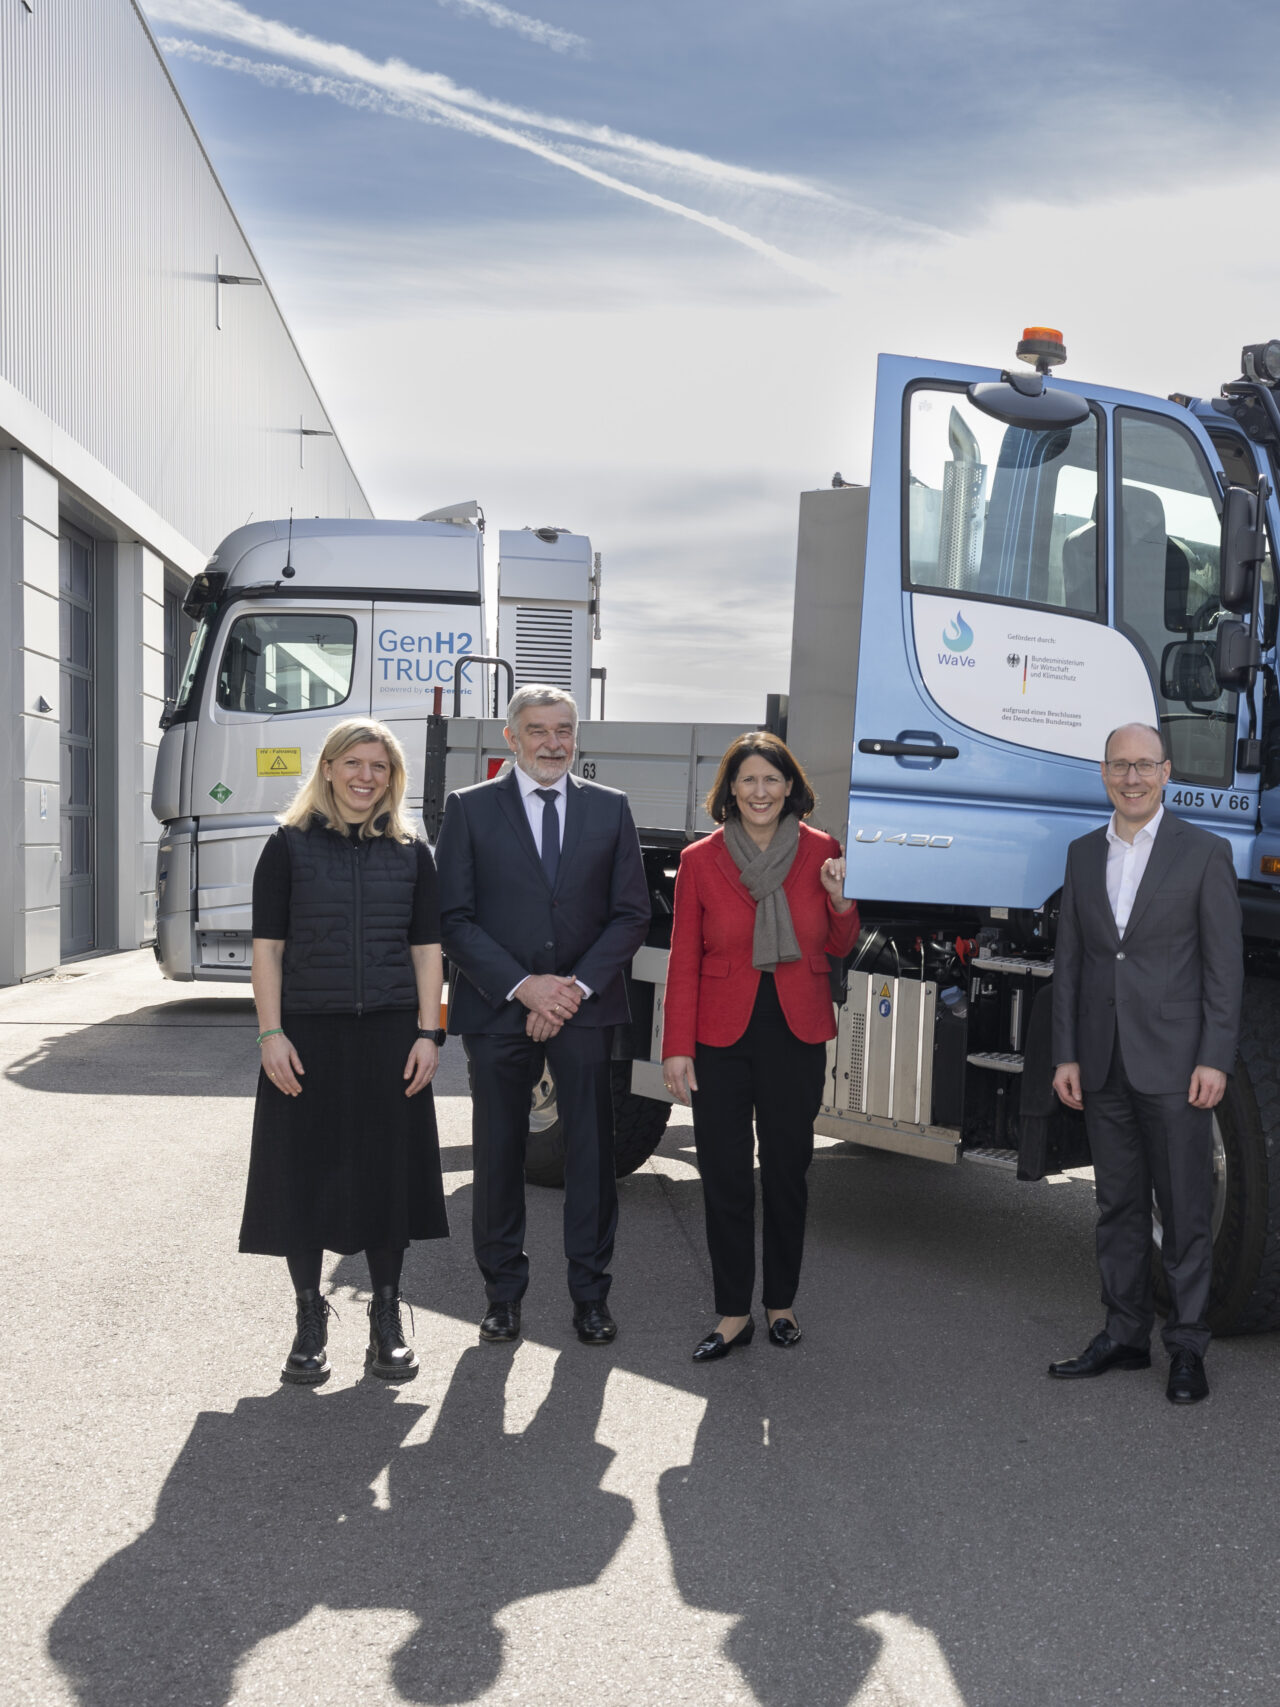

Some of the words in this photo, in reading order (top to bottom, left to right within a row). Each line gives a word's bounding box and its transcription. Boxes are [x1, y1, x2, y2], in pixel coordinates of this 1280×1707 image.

[378, 629, 473, 655] GenH2
[1007, 633, 1036, 643] Gefördert
[1037, 636, 1057, 644] durch:
[937, 653, 976, 668] WaVe
[1031, 655, 1085, 667] Bundesministerium
[377, 657, 474, 684] TRUCK
[1030, 663, 1039, 671] für
[1040, 664, 1069, 673] Wirtschaft
[1030, 671, 1041, 679] und
[1042, 672, 1077, 682] Klimaschutz
[380, 686, 412, 694] powered
[414, 686, 423, 695] by
[1002, 707, 1030, 716] aufgrund
[1047, 710, 1082, 719] Beschlusses
[1013, 714, 1045, 724] Deutschen
[1045, 717, 1082, 728] Bundestages
[583, 762, 596, 780] 63
[1172, 790, 1205, 808] 405
[1210, 793, 1223, 809] V
[1229, 794, 1250, 811] 66
[855, 828, 883, 843] U
[884, 832, 954, 848] 430
